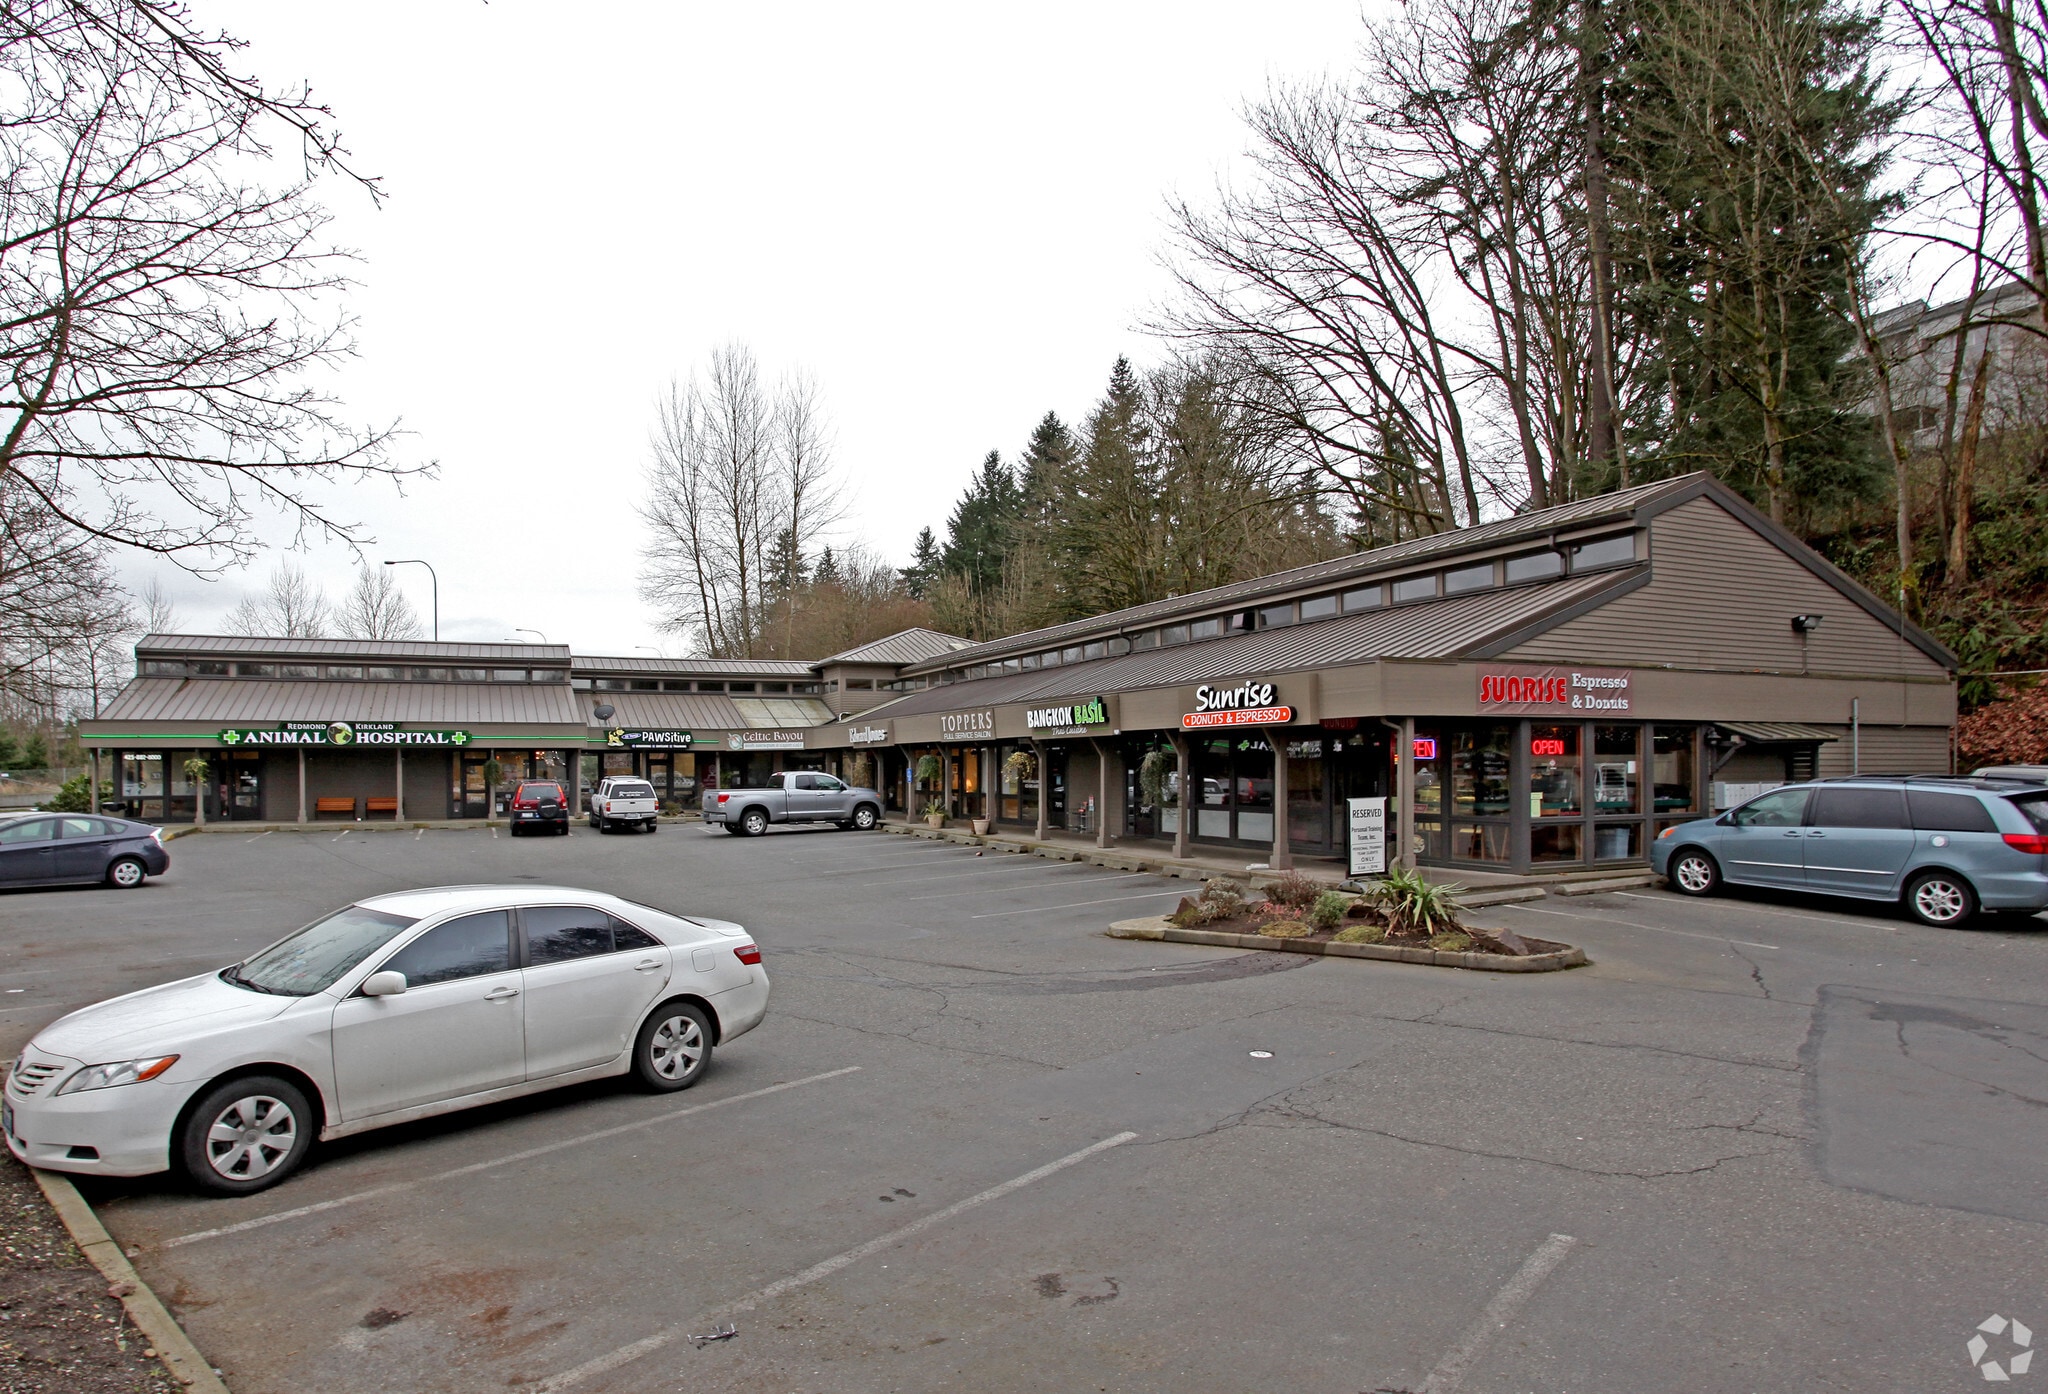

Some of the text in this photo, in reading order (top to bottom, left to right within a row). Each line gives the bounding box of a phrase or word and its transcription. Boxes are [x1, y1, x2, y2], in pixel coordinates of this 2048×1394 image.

[1480, 675, 1567, 703] SUNRISE
[1571, 673, 1628, 691] Espresso
[1196, 681, 1273, 711] Sunrise
[1571, 694, 1629, 709] & Donuts
[941, 711, 992, 731] TOPPERS
[1027, 701, 1105, 728] BANGKOK BASIL
[1190, 709, 1280, 725] DONUTS & ESPRESSO
[287, 722, 394, 730] REDMOND KIRKLAND
[243, 731, 449, 744] ANIMAL HOSPITAL
[642, 731, 691, 742] PAWSitive
[974, 730, 991, 739] SALON
[1532, 740, 1564, 754] OPEN
[1352, 808, 1382, 819] RESERVED
